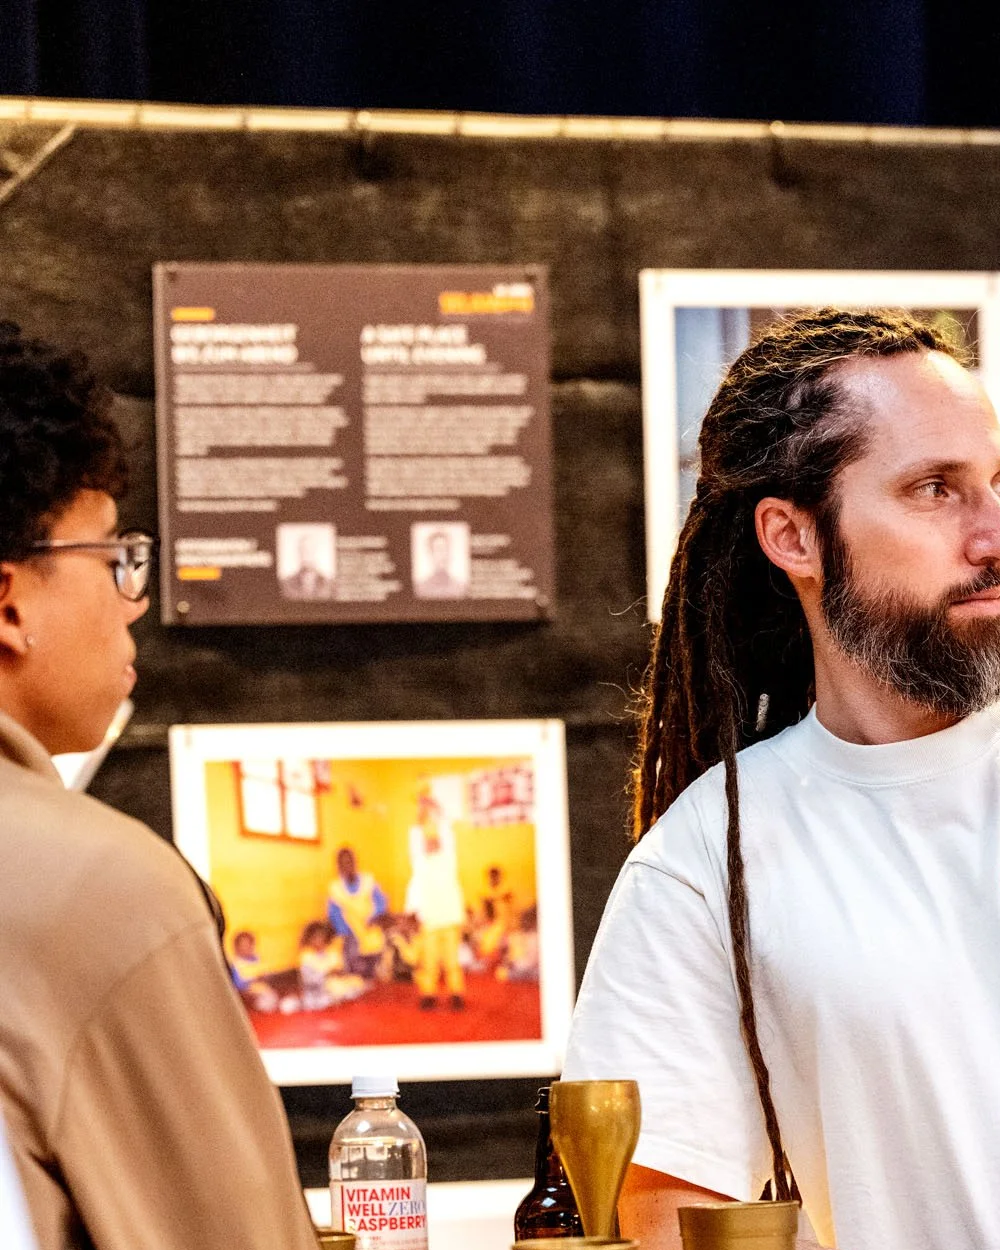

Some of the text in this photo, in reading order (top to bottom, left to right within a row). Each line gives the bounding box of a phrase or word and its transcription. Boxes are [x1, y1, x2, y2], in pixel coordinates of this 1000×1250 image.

[346, 1186, 411, 1202] VITAMIN
[347, 1201, 426, 1217] WELL ZERO
